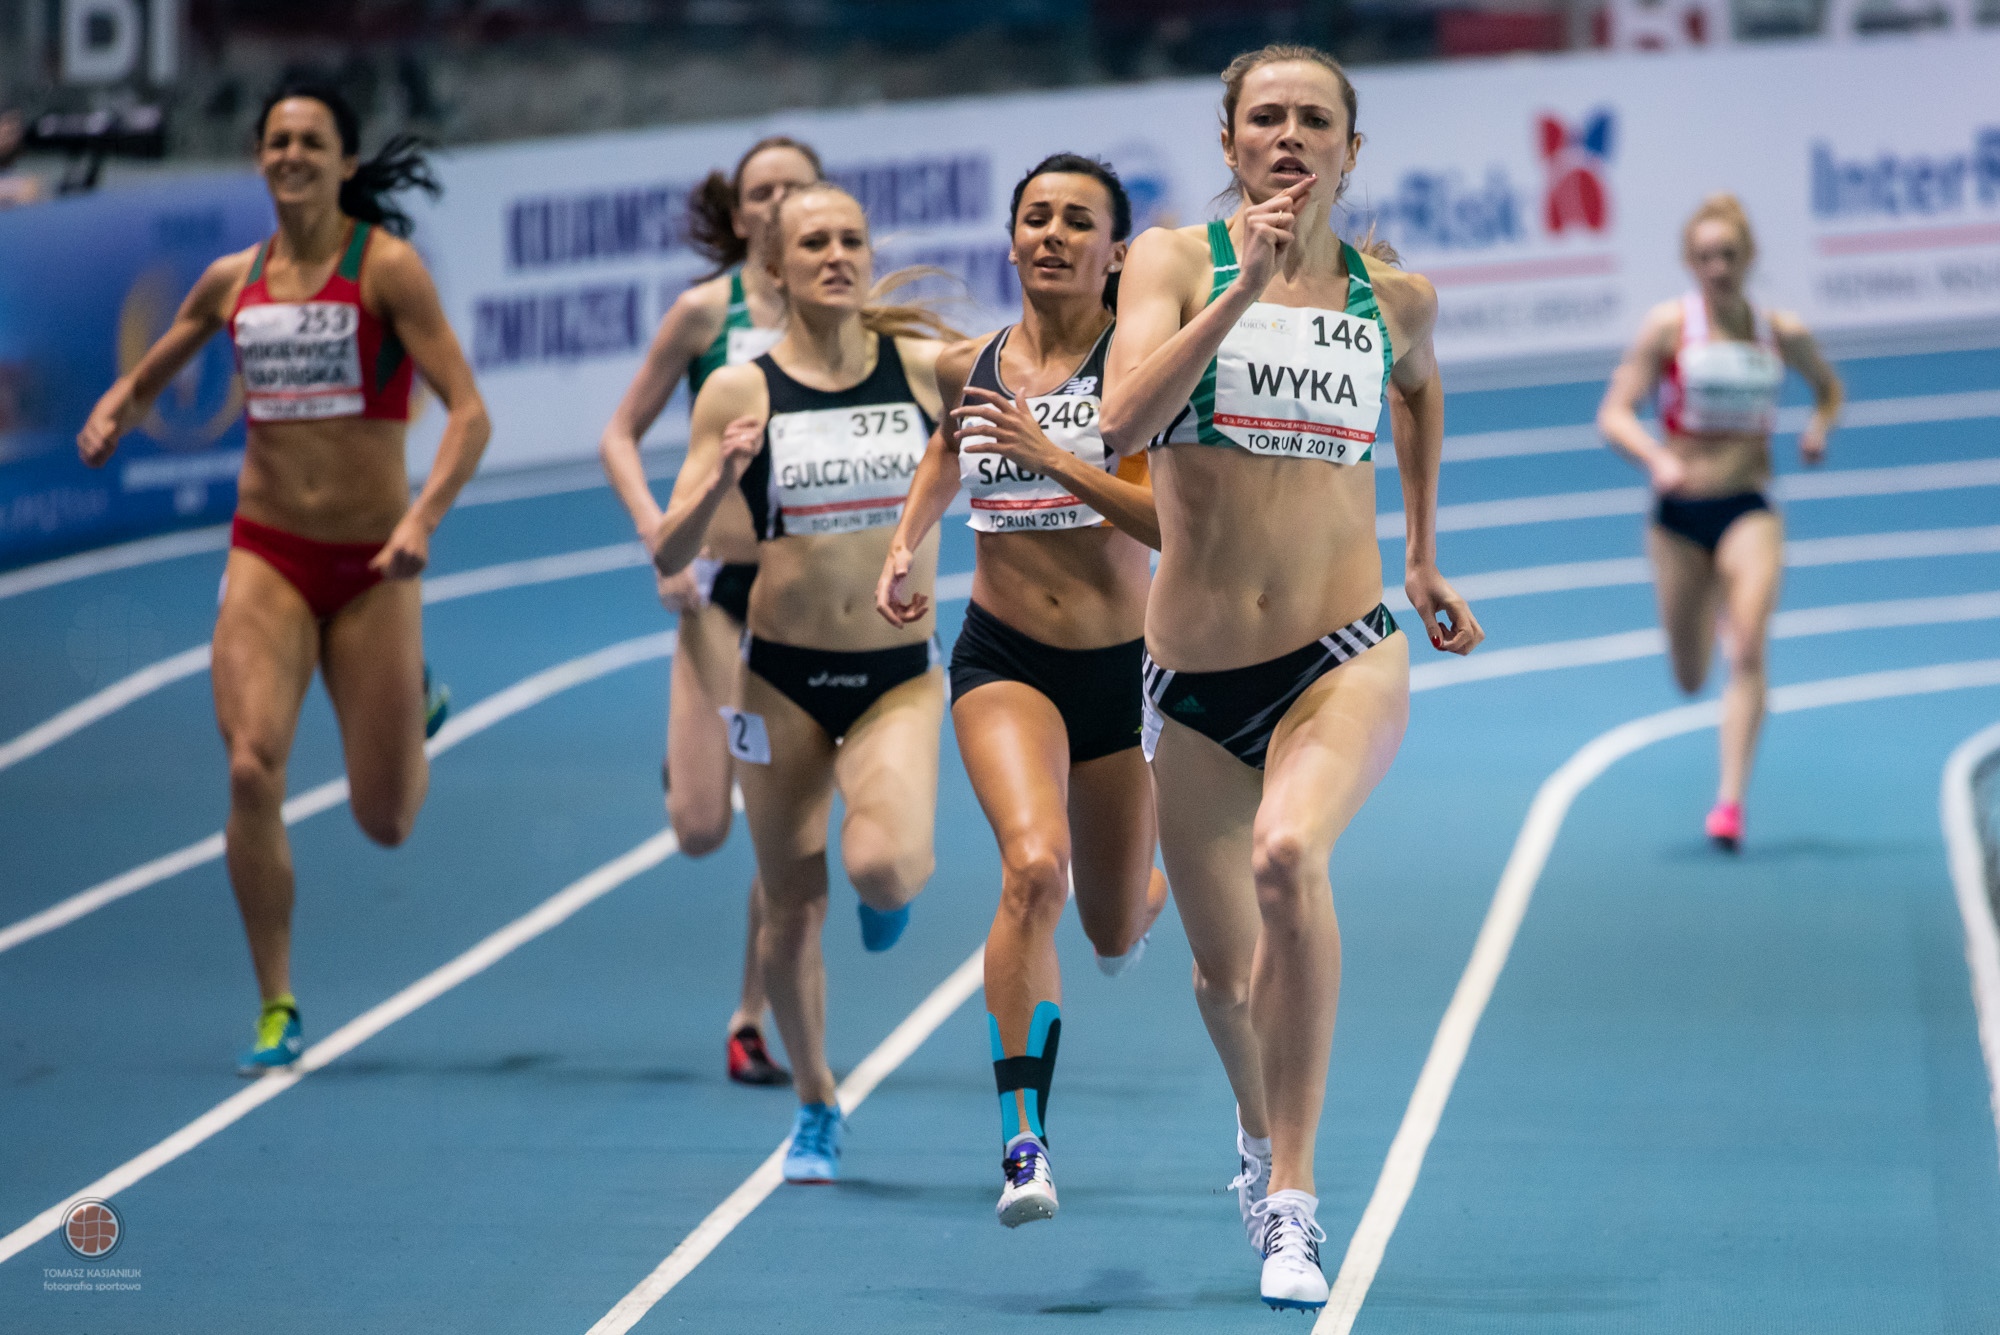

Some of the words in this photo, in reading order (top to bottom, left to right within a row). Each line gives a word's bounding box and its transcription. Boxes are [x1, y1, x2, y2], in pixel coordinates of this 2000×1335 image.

[1311, 315, 1373, 353] 146
[1247, 362, 1358, 408] WYKA
[851, 410, 909, 437] 375
[1034, 401, 1095, 430] 240
[1236, 418, 1259, 427] PZLA
[1260, 421, 1293, 430] HALOWE
[1247, 432, 1303, 452] TORUŃ
[1306, 439, 1347, 459] 2019
[782, 450, 919, 490] GULCZYŃSKA
[1040, 510, 1078, 527] 2019
[733, 713, 748, 752] 2
